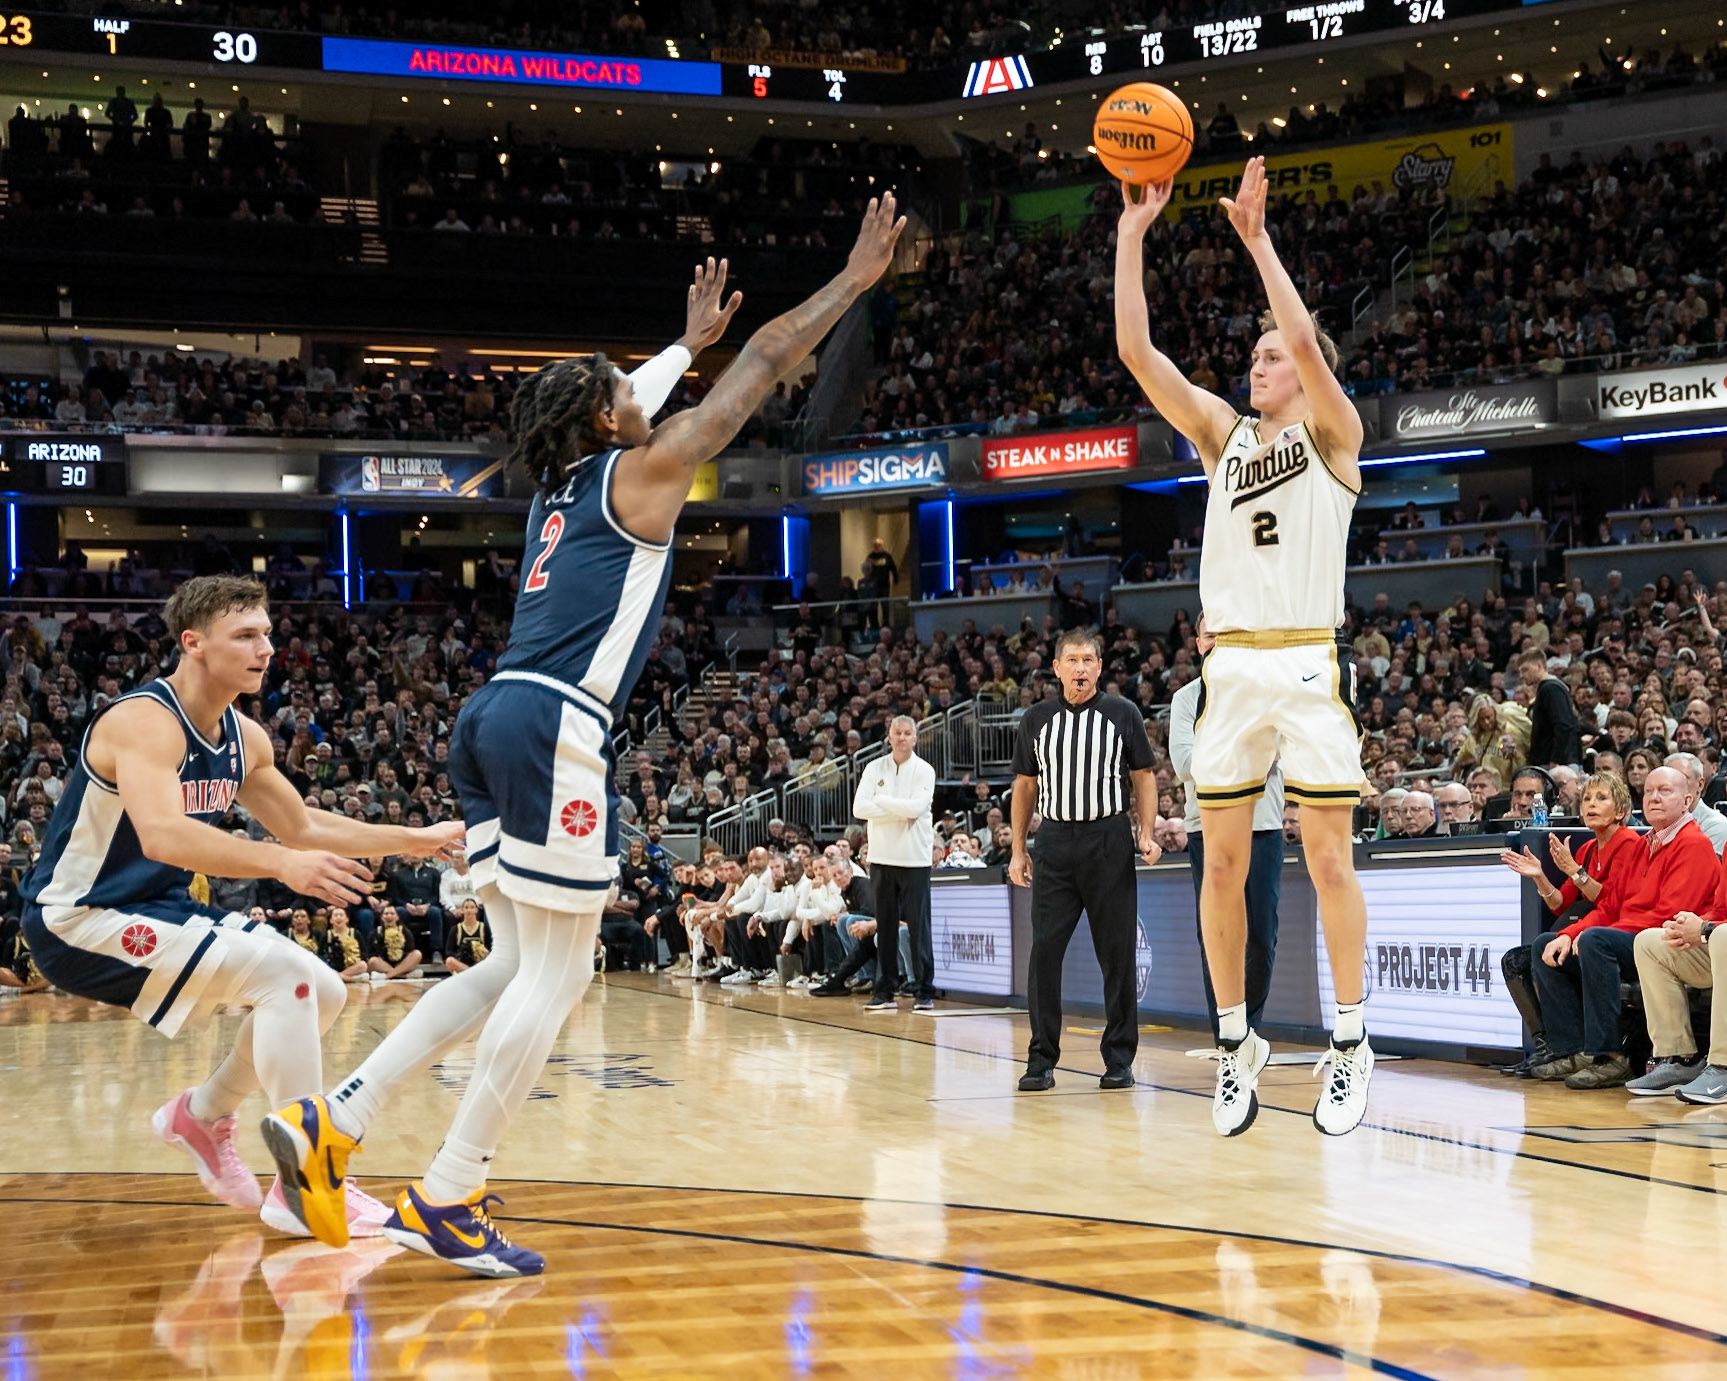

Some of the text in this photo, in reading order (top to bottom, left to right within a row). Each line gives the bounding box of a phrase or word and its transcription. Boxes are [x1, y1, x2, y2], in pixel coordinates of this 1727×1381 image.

[1286, 0, 1366, 24] FREE THROWS
[1408, 2, 1446, 24] 3/4
[93, 18, 131, 34] HALF
[1193, 15, 1263, 39] FIELD GOALS
[1309, 15, 1344, 41] 1/2
[106, 33, 117, 55] 1
[212, 31, 258, 64] 30
[1140, 32, 1163, 48] AST
[1200, 29, 1258, 58] 13/22
[409, 49, 642, 86] ARIZONA WILDCATS
[1089, 55, 1103, 75] 8
[1141, 45, 1165, 68] 10
[753, 78, 768, 98] 5
[823, 69, 847, 83] TOL
[828, 82, 843, 102] 4
[1098, 127, 1156, 151] Wilson
[1469, 131, 1502, 148] 101
[1400, 153, 1454, 185] Starry
[1601, 376, 1717, 410] KeyBank
[1397, 390, 1540, 433] Chateau Ste Michelle
[28, 442, 102, 462] ARIZONA
[987, 437, 1129, 469] STEAK N SHAKE
[61, 465, 87, 487] 30
[805, 451, 946, 490] SHIPSIGMA
[1225, 441, 1309, 495] Purdue
[1251, 510, 1280, 547] 2
[524, 511, 566, 594] 2
[952, 933, 995, 963] PROJECT 44
[1377, 943, 1492, 996] PROJECT 44
